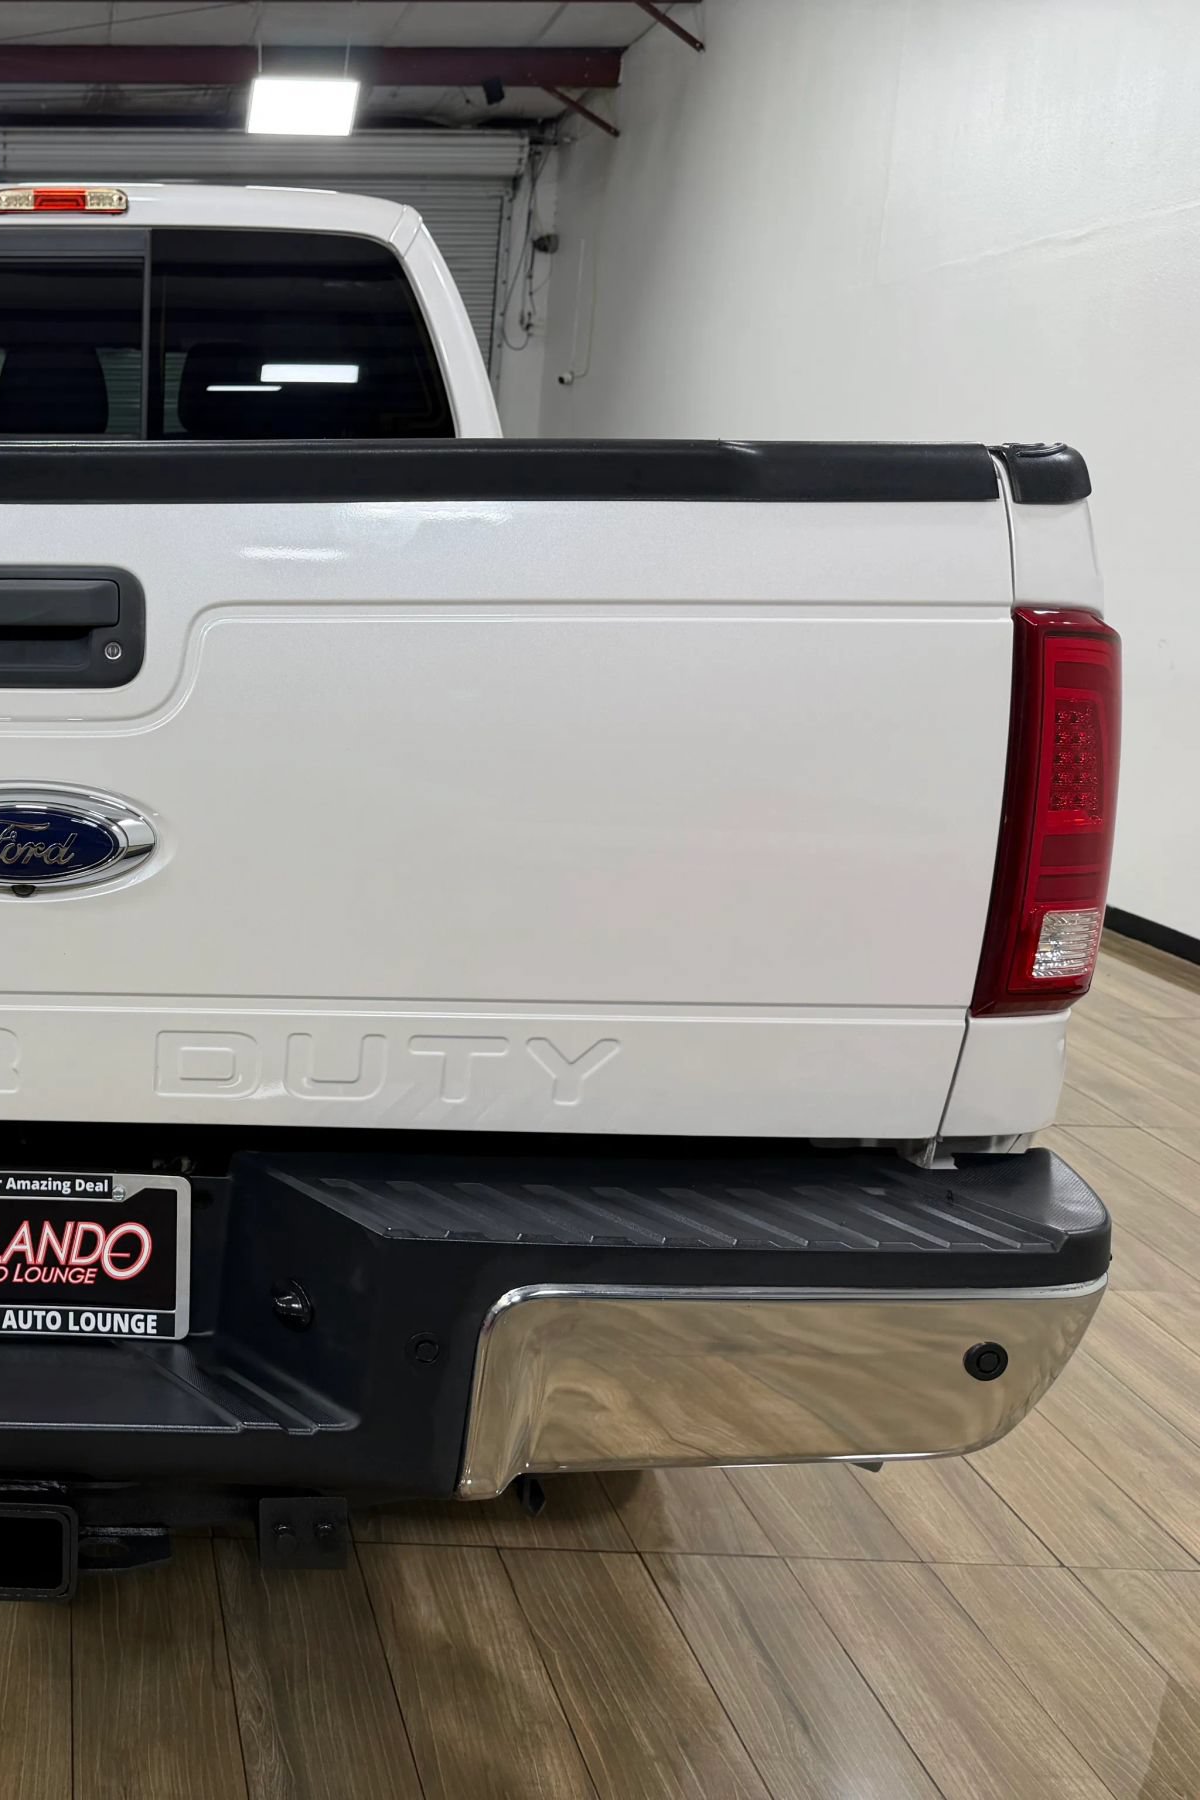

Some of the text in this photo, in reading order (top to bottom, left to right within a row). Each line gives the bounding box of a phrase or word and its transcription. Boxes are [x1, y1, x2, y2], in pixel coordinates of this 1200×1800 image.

[153, 1029, 622, 1106] DUTY
[5, 1177, 72, 1194] Amazing
[75, 1178, 109, 1193] Deal
[12, 1263, 99, 1285] LOUNGE
[1, 1309, 62, 1332] AUTO
[68, 1311, 158, 1335] LOUNGE
